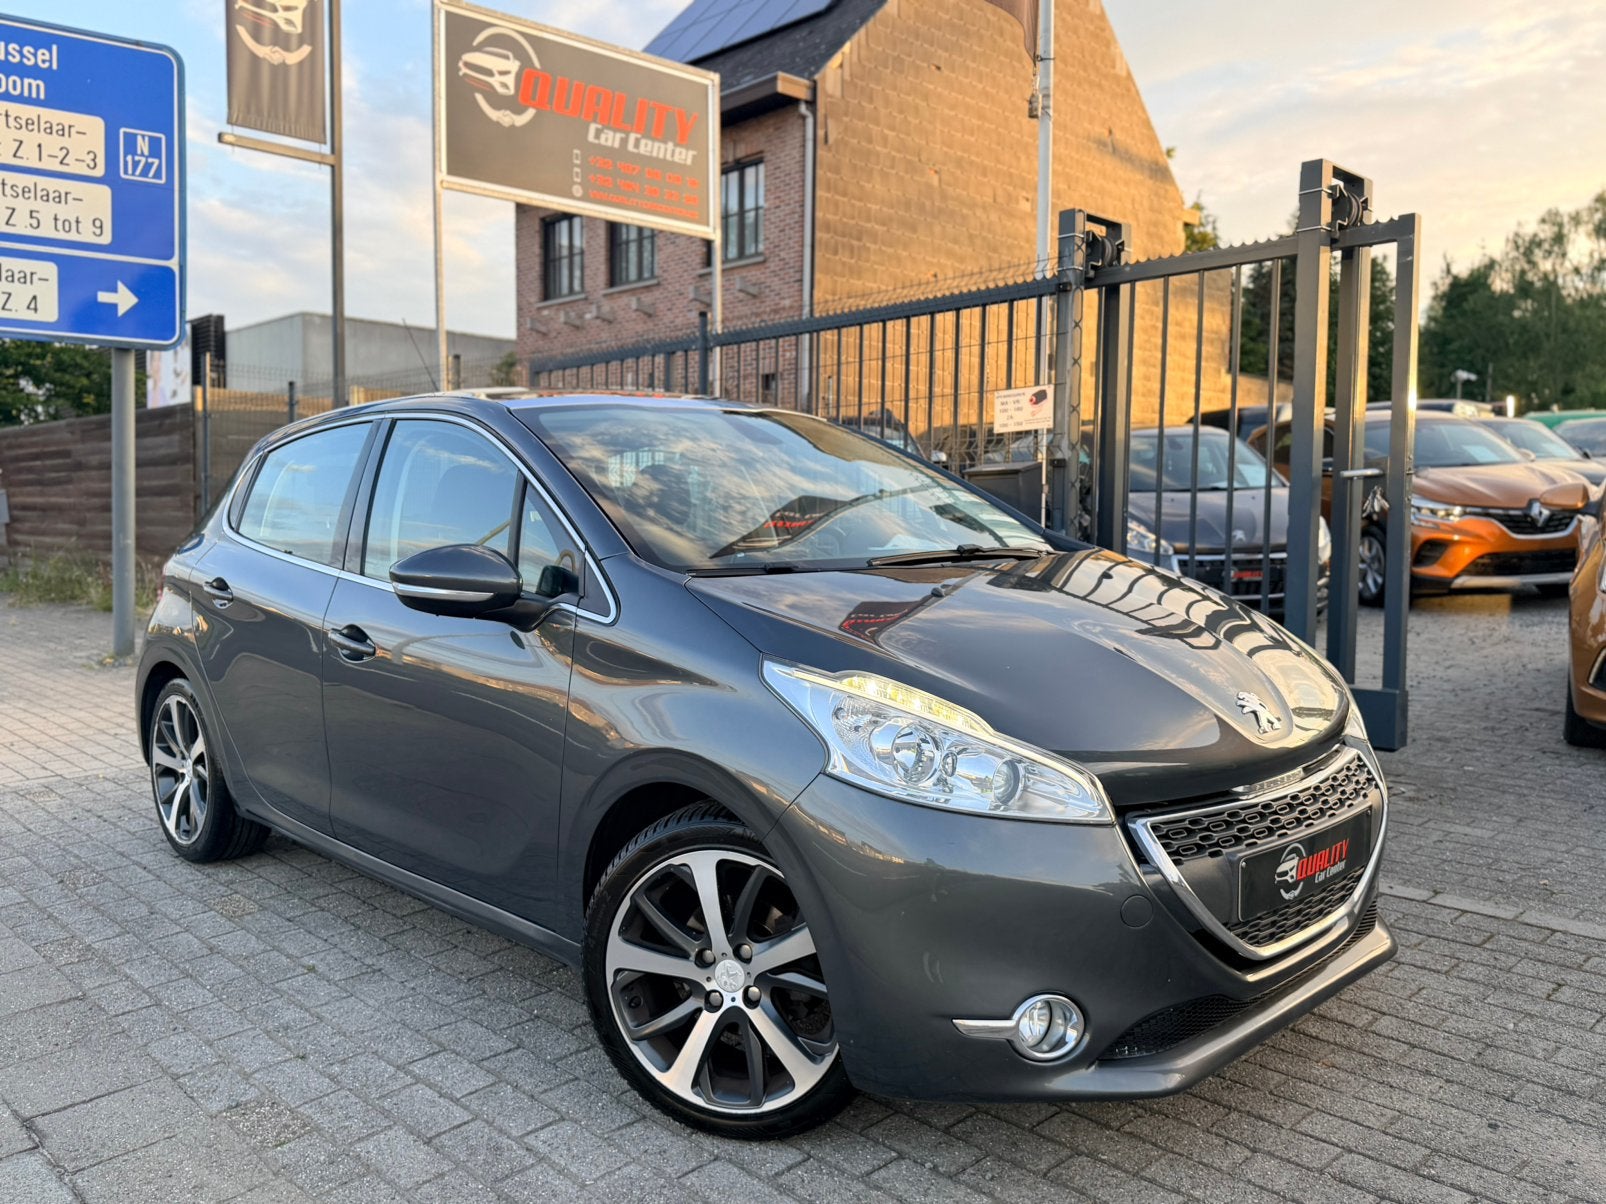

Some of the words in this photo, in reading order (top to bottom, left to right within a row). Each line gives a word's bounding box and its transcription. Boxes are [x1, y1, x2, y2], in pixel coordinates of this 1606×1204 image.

[518, 67, 698, 145] QUALITY
[0, 109, 87, 138] tselaar-
[136, 135, 149, 156] N
[587, 122, 626, 149] Car
[627, 132, 697, 165] Center
[125, 154, 160, 179] 177
[53, 213, 82, 235] tot
[92, 217, 104, 238] 9
[26, 294, 39, 314] 4
[1297, 838, 1349, 881] QUALITY
[1315, 870, 1326, 883] Car
[1326, 859, 1346, 877] Center
